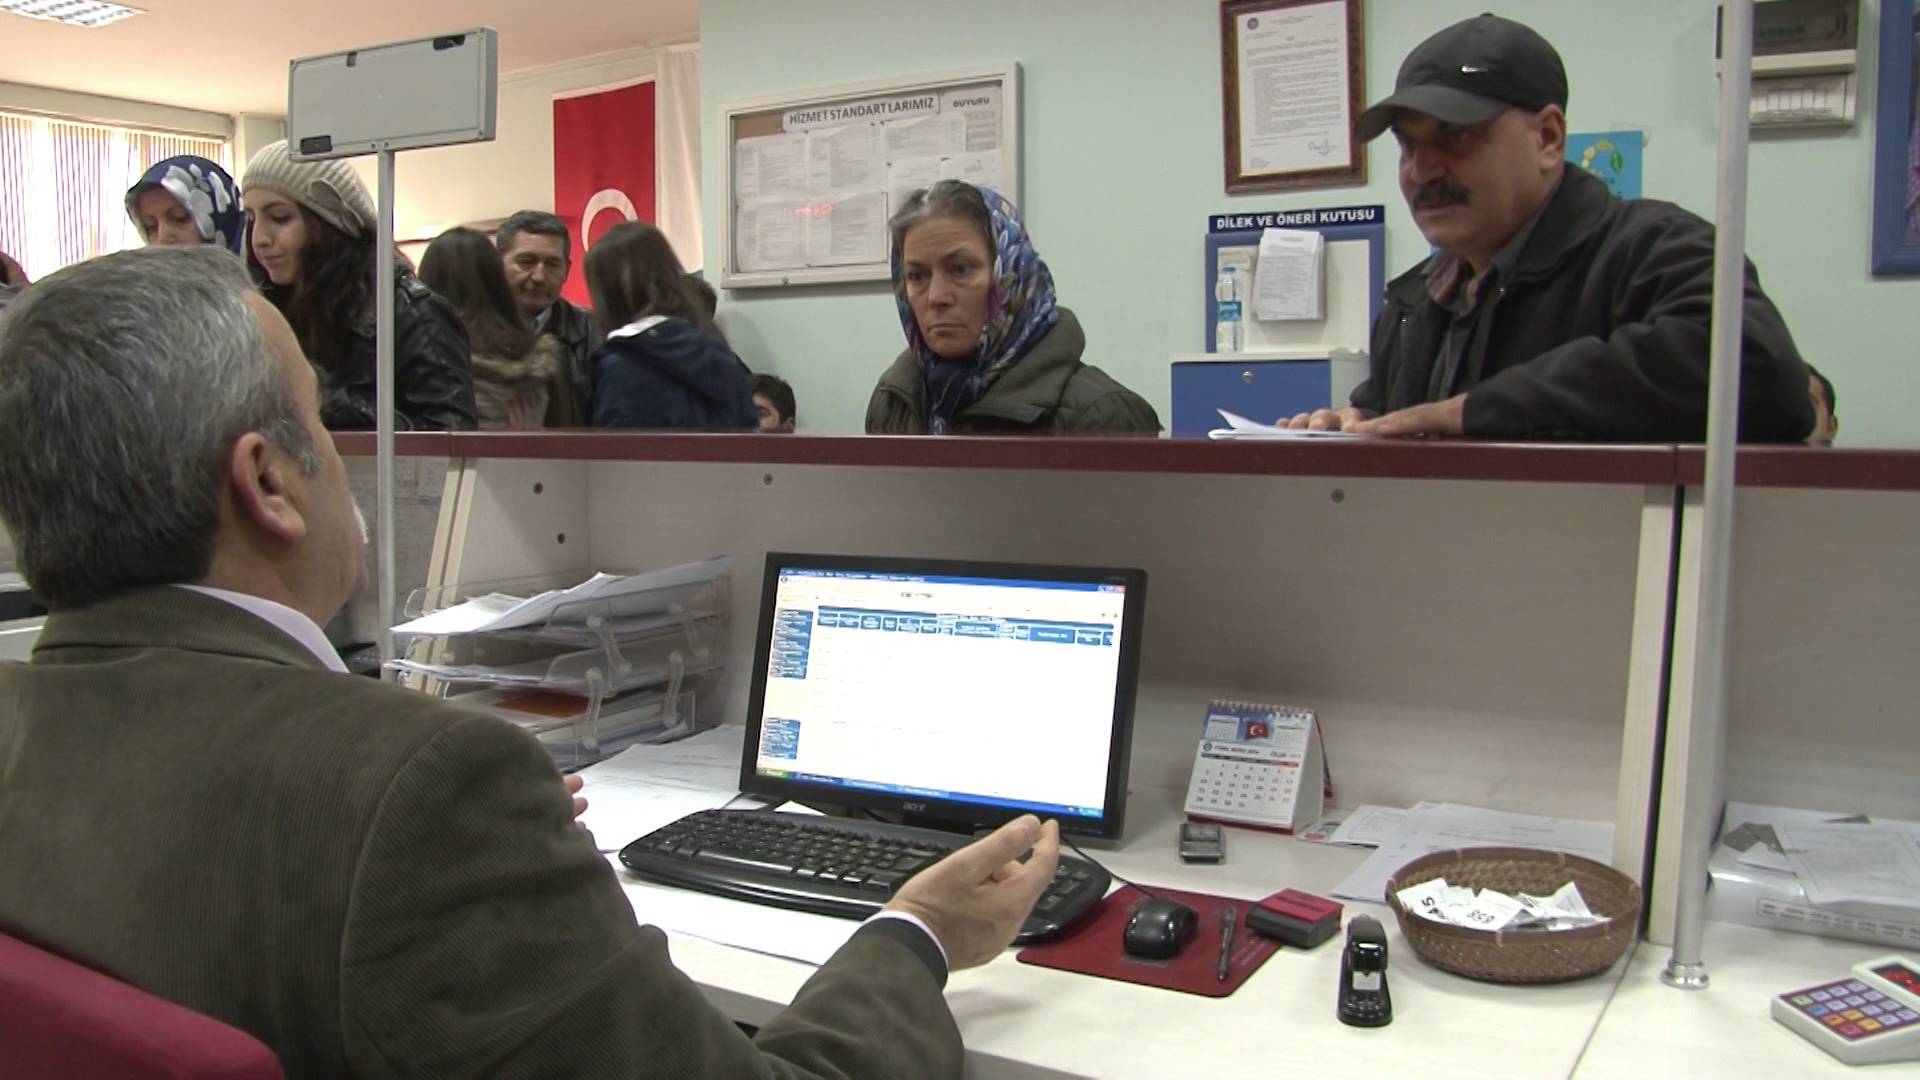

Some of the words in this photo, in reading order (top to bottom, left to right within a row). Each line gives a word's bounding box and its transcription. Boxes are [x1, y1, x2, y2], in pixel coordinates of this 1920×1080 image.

[790, 109, 829, 125] HİZMET
[829, 104, 885, 121] STANDART
[888, 97, 934, 113] LARIMIZ
[1216, 218, 1253, 230] DİLEK
[1257, 215, 1273, 227] VE
[1276, 210, 1316, 226] ÖNERİ
[1319, 209, 1375, 223] KUTUSU
